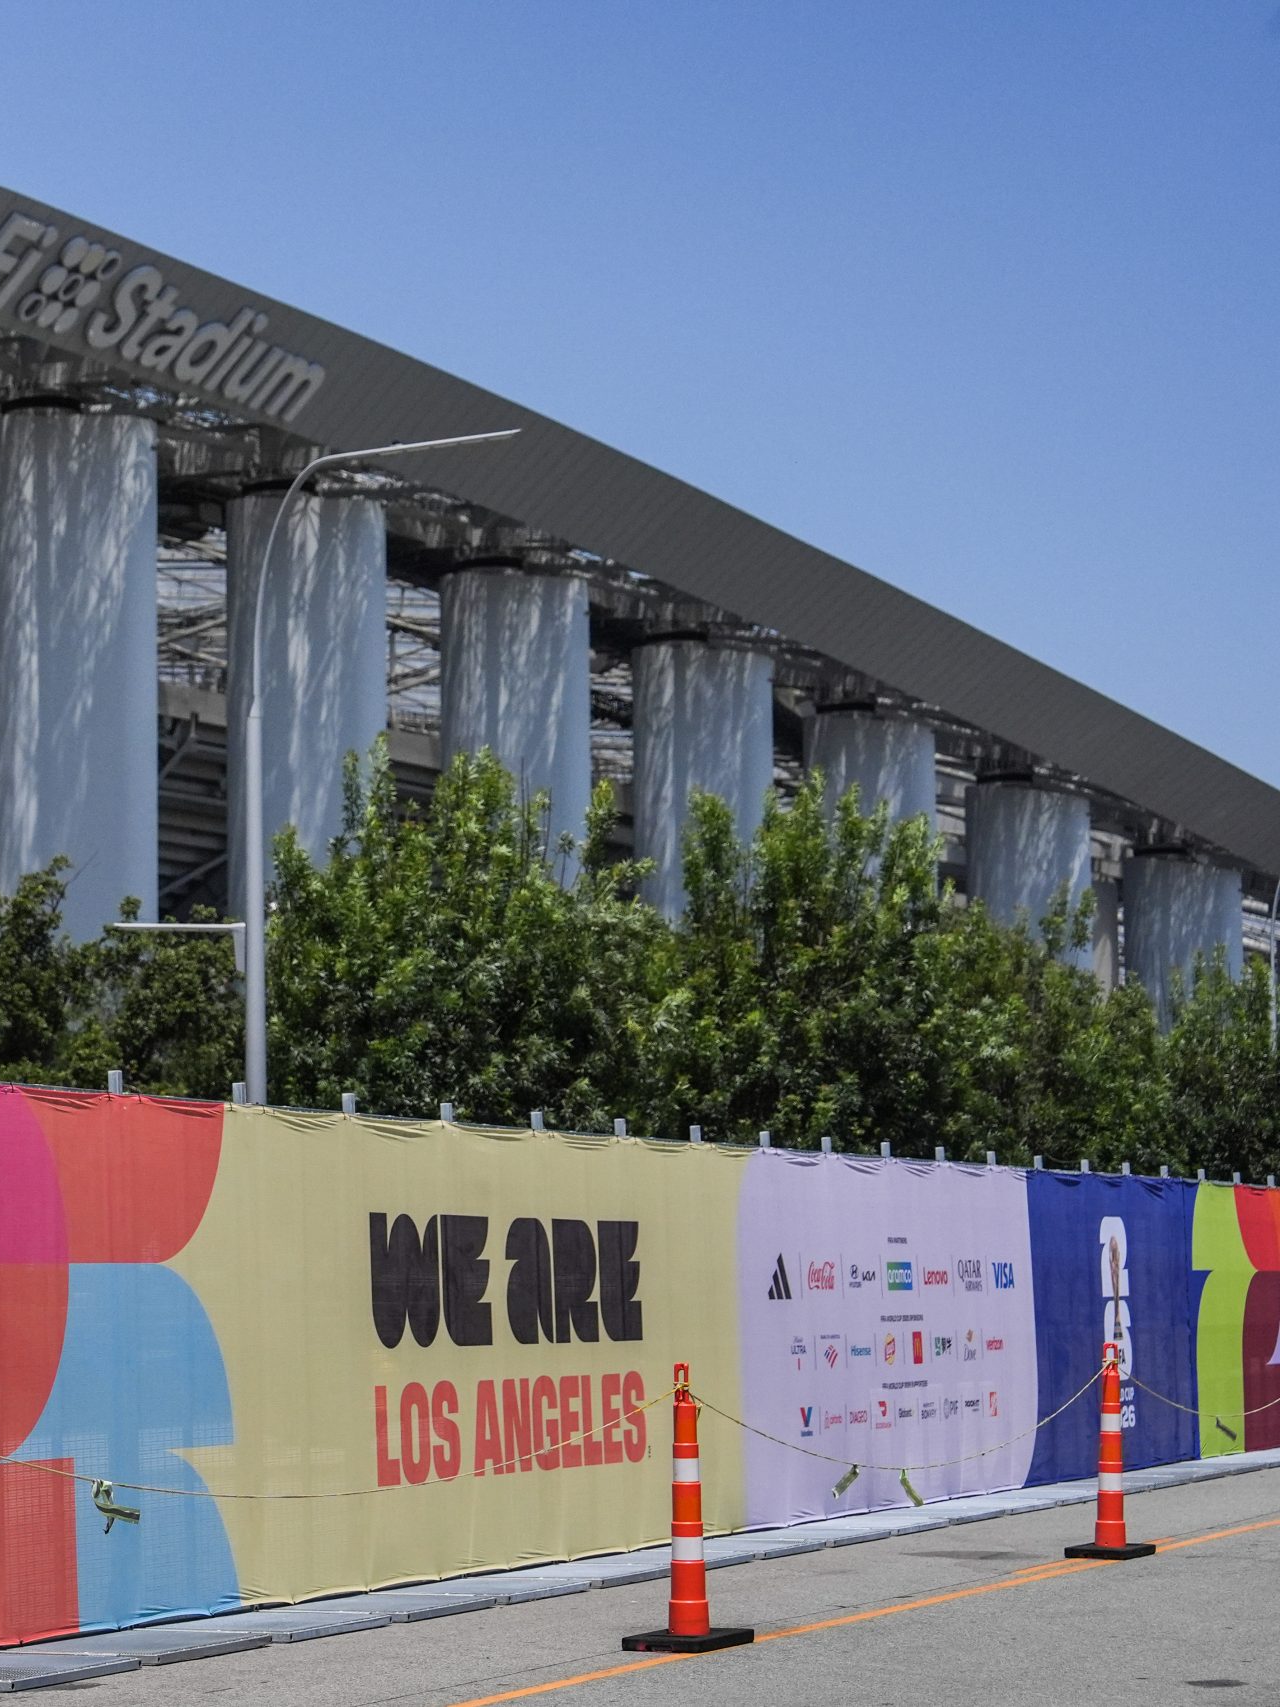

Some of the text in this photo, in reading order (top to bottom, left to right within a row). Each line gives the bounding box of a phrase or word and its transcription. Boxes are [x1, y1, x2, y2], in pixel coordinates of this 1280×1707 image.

[88, 265, 326, 423] Stadium
[369, 1212, 643, 1349] WE ARE
[887, 1268, 912, 1283] aramco
[923, 1267, 948, 1285] Lenovo
[957, 1260, 982, 1280] QATAR
[991, 1262, 1015, 1289] VISA
[850, 1345, 871, 1356] Hisense
[374, 1370, 646, 1487] LOS ANGELES
[1121, 1405, 1136, 1429] 26
